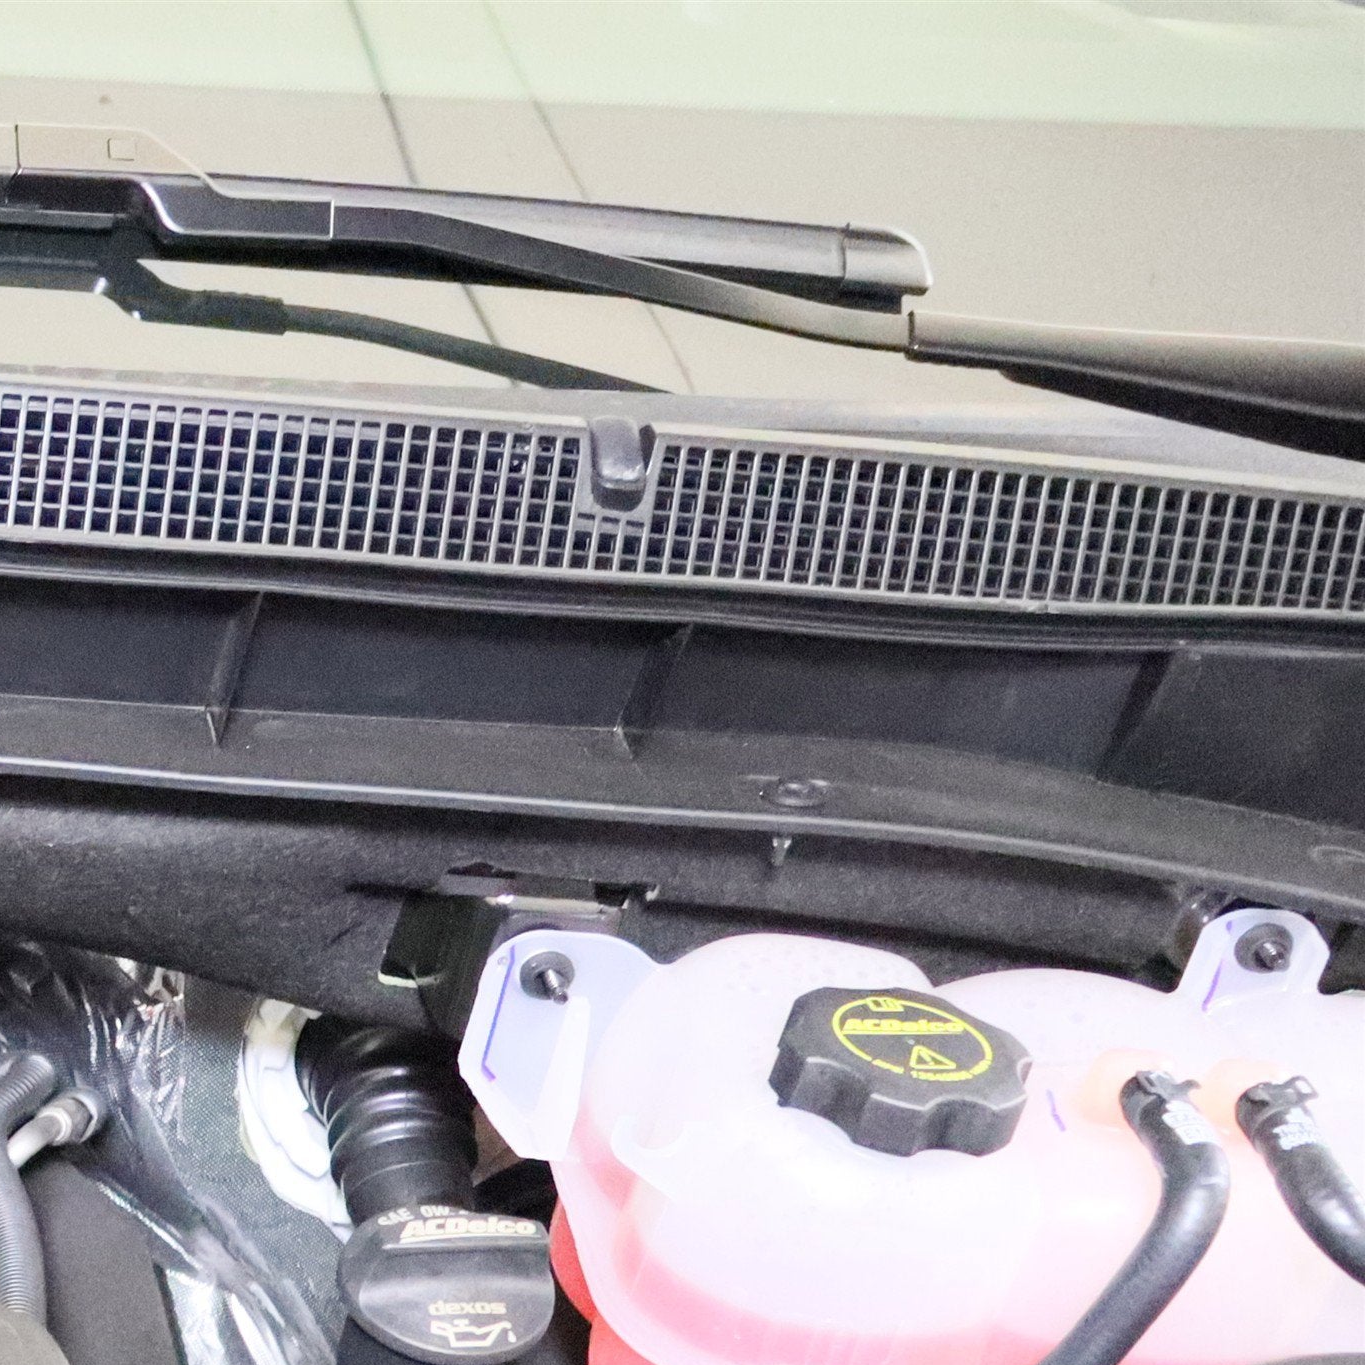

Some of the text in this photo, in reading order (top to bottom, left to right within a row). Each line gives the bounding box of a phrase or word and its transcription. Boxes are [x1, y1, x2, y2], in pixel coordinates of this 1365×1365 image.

[842, 1018, 965, 1033] ACDelco
[377, 1207, 415, 1226] SAE
[400, 1216, 537, 1238] ACDelco
[428, 1300, 507, 1316] dexos
